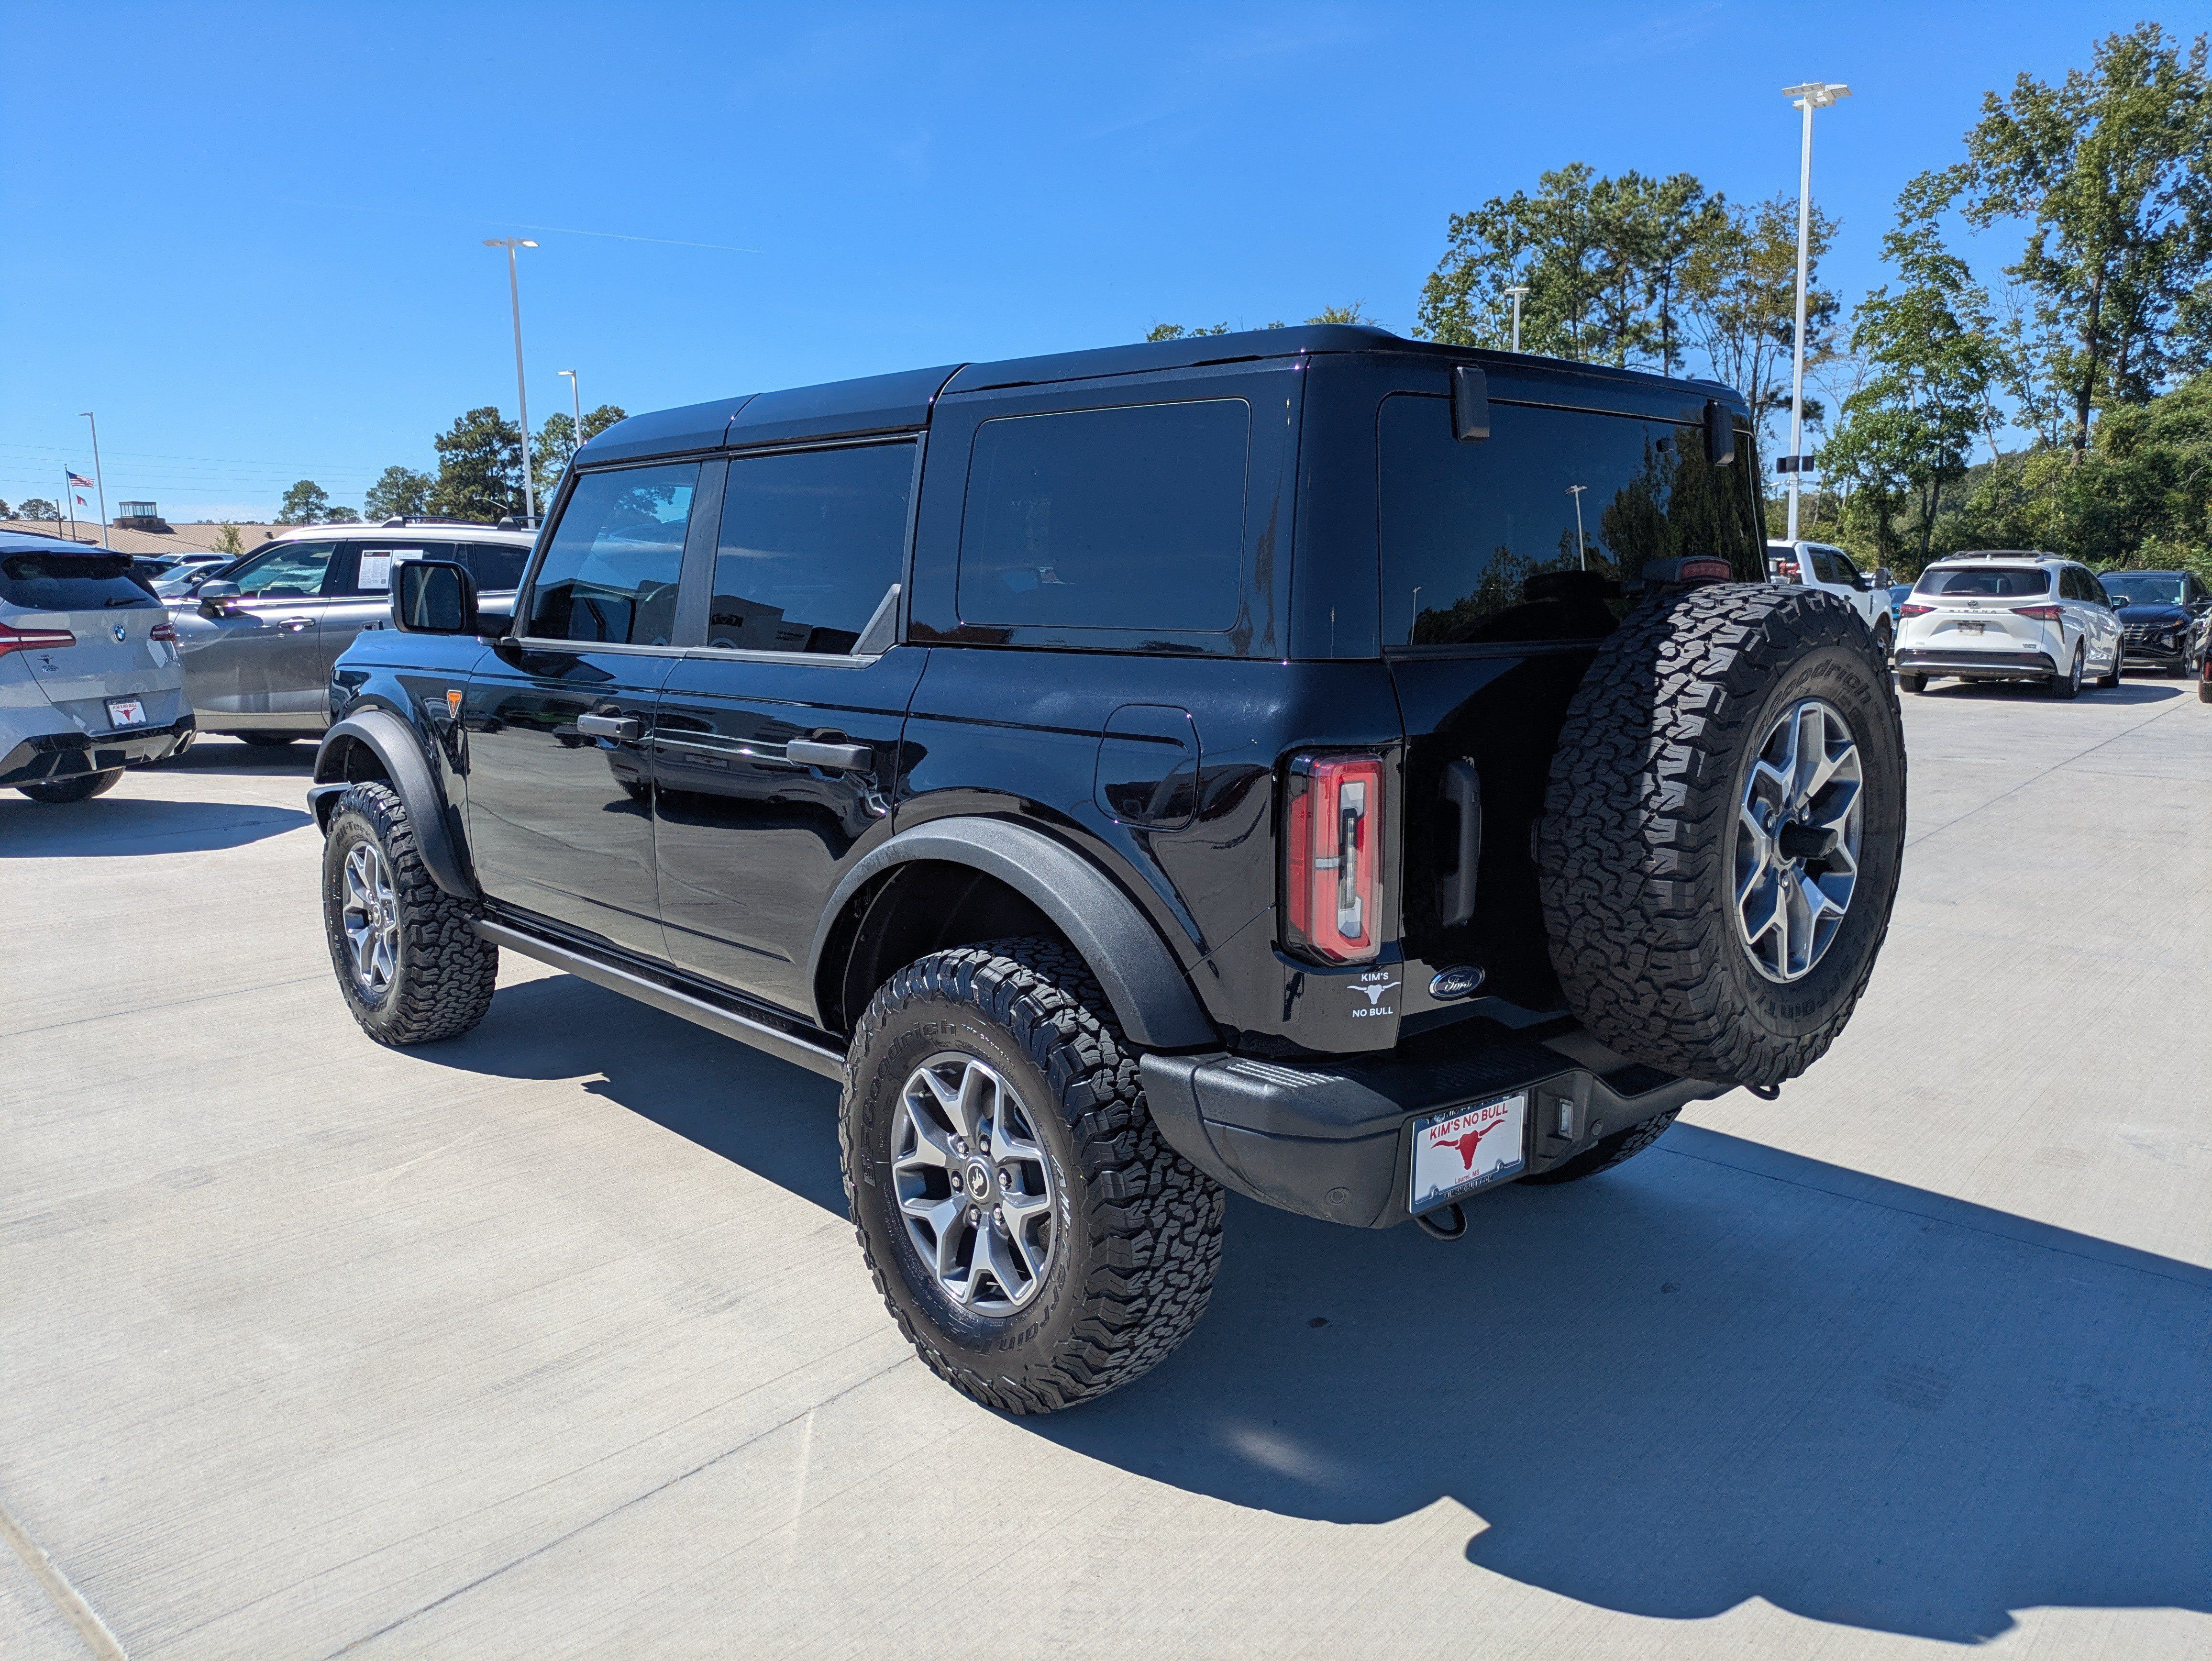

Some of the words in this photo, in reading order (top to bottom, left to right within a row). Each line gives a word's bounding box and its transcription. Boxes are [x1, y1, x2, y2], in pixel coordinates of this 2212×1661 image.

[1361, 972, 1389, 982] KIM'S
[1444, 974, 1473, 992] Ford
[1352, 1008, 1367, 1018] NO
[1369, 1007, 1393, 1016] BULL
[1429, 1118, 1460, 1141] KIM'S
[1463, 1112, 1479, 1129] NO
[1481, 1103, 1508, 1122] BULL
[1454, 1174, 1471, 1185] Laurel,
[1472, 1169, 1480, 1177] MS
